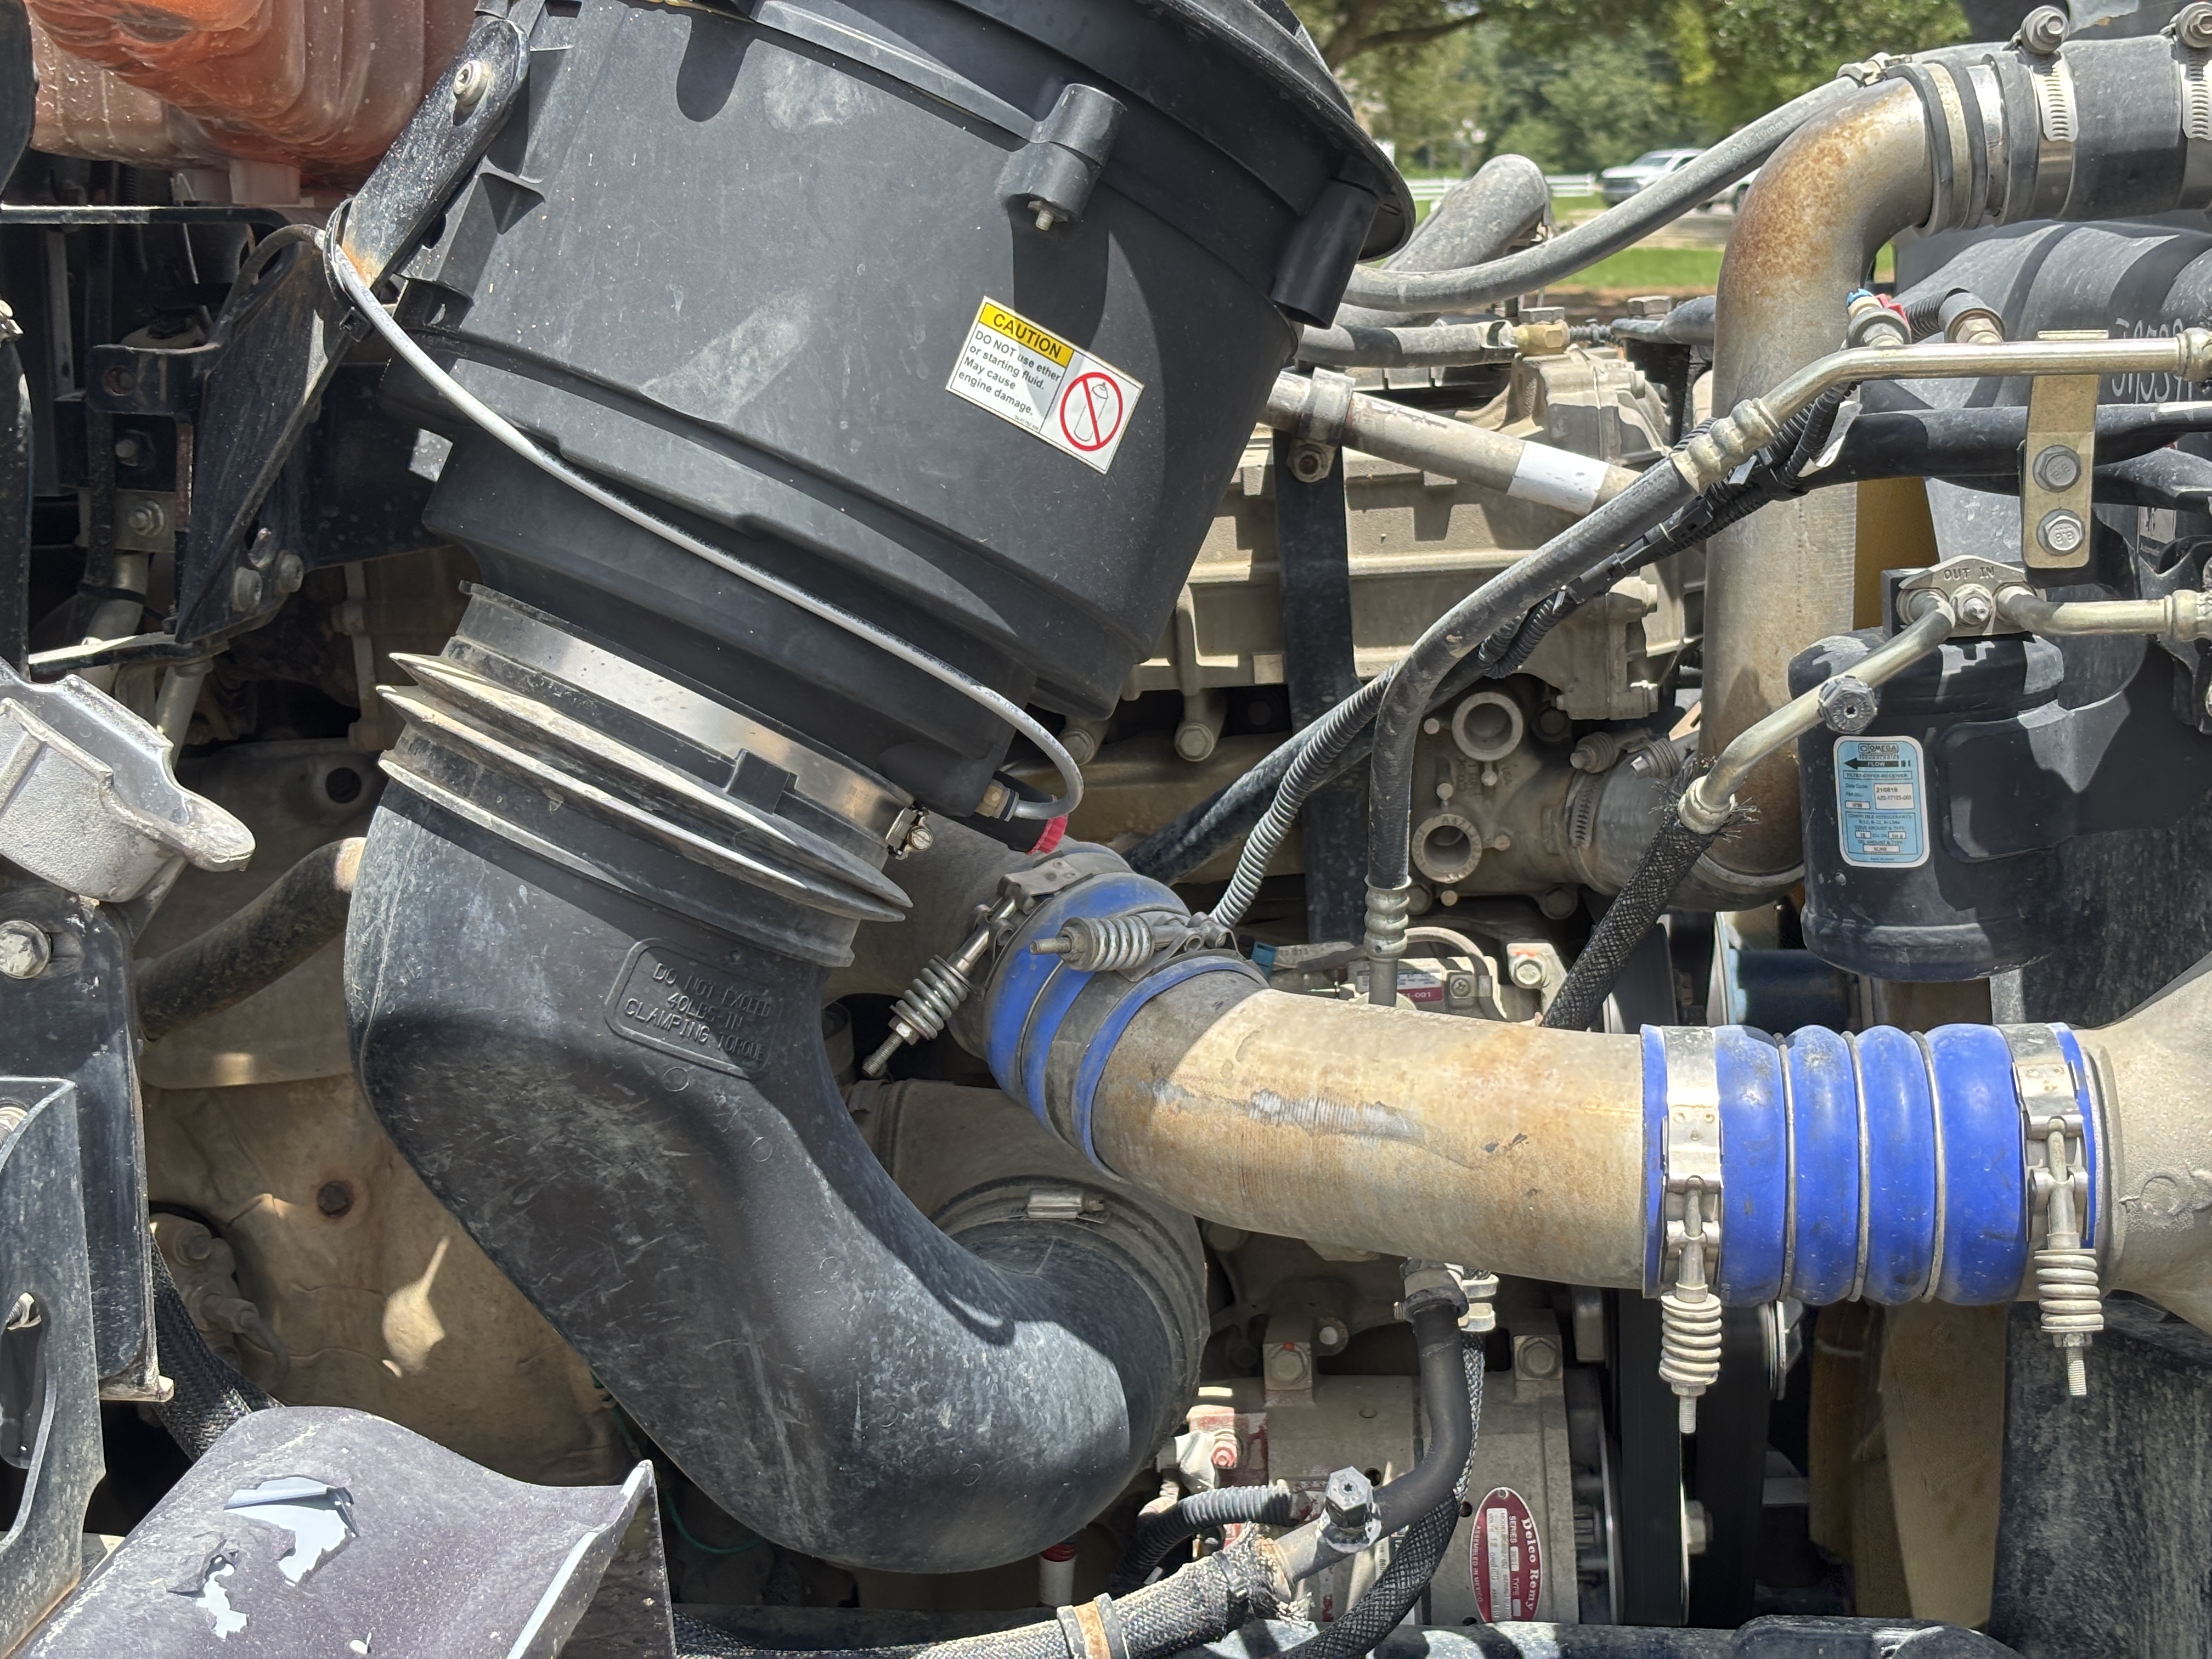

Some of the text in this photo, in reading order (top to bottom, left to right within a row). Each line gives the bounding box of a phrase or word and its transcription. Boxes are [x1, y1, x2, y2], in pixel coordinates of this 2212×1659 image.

[975, 330, 1061, 382] DO NOT use ether
[993, 313, 1062, 359] CAUTION
[964, 357, 1016, 390] May cause
[970, 346, 1045, 390] or starting fluid.
[958, 371, 1033, 416] engine damage.
[1944, 566, 1995, 581] OUT IN
[1869, 744, 1898, 753] OMEGA
[652, 962, 771, 1018] DO NOT EXCEED
[624, 997, 766, 1062] CLAMPING TORQUE
[1471, 1525, 1482, 1566] ASSEMBLED
[1509, 1515, 1517, 1544] SERIES
[1521, 1517, 1539, 1611] Delco Remy
[1474, 1577, 1483, 1602] MEXICO
[1511, 1577, 1520, 1596] TYPE
